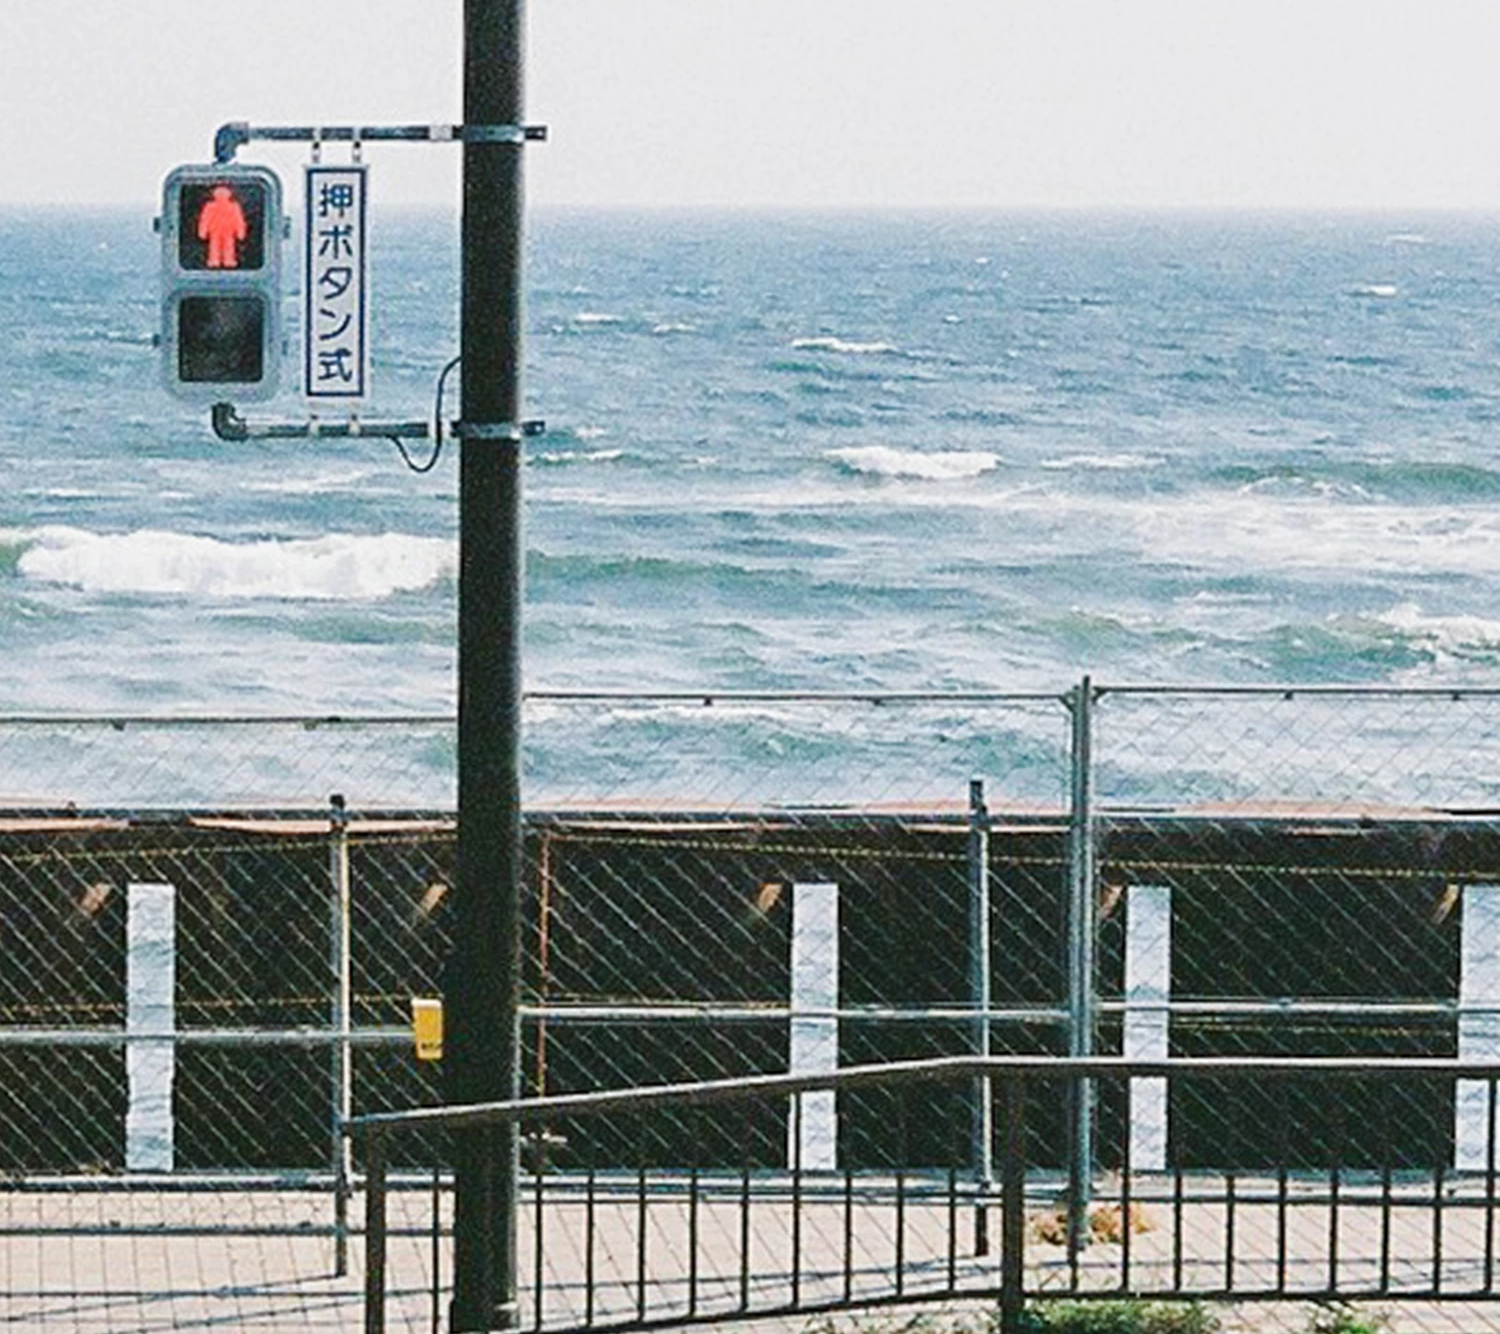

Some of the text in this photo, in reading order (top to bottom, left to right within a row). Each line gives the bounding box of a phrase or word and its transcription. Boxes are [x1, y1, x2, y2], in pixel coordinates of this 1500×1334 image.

[318, 182, 354, 384] 押ボタン式
